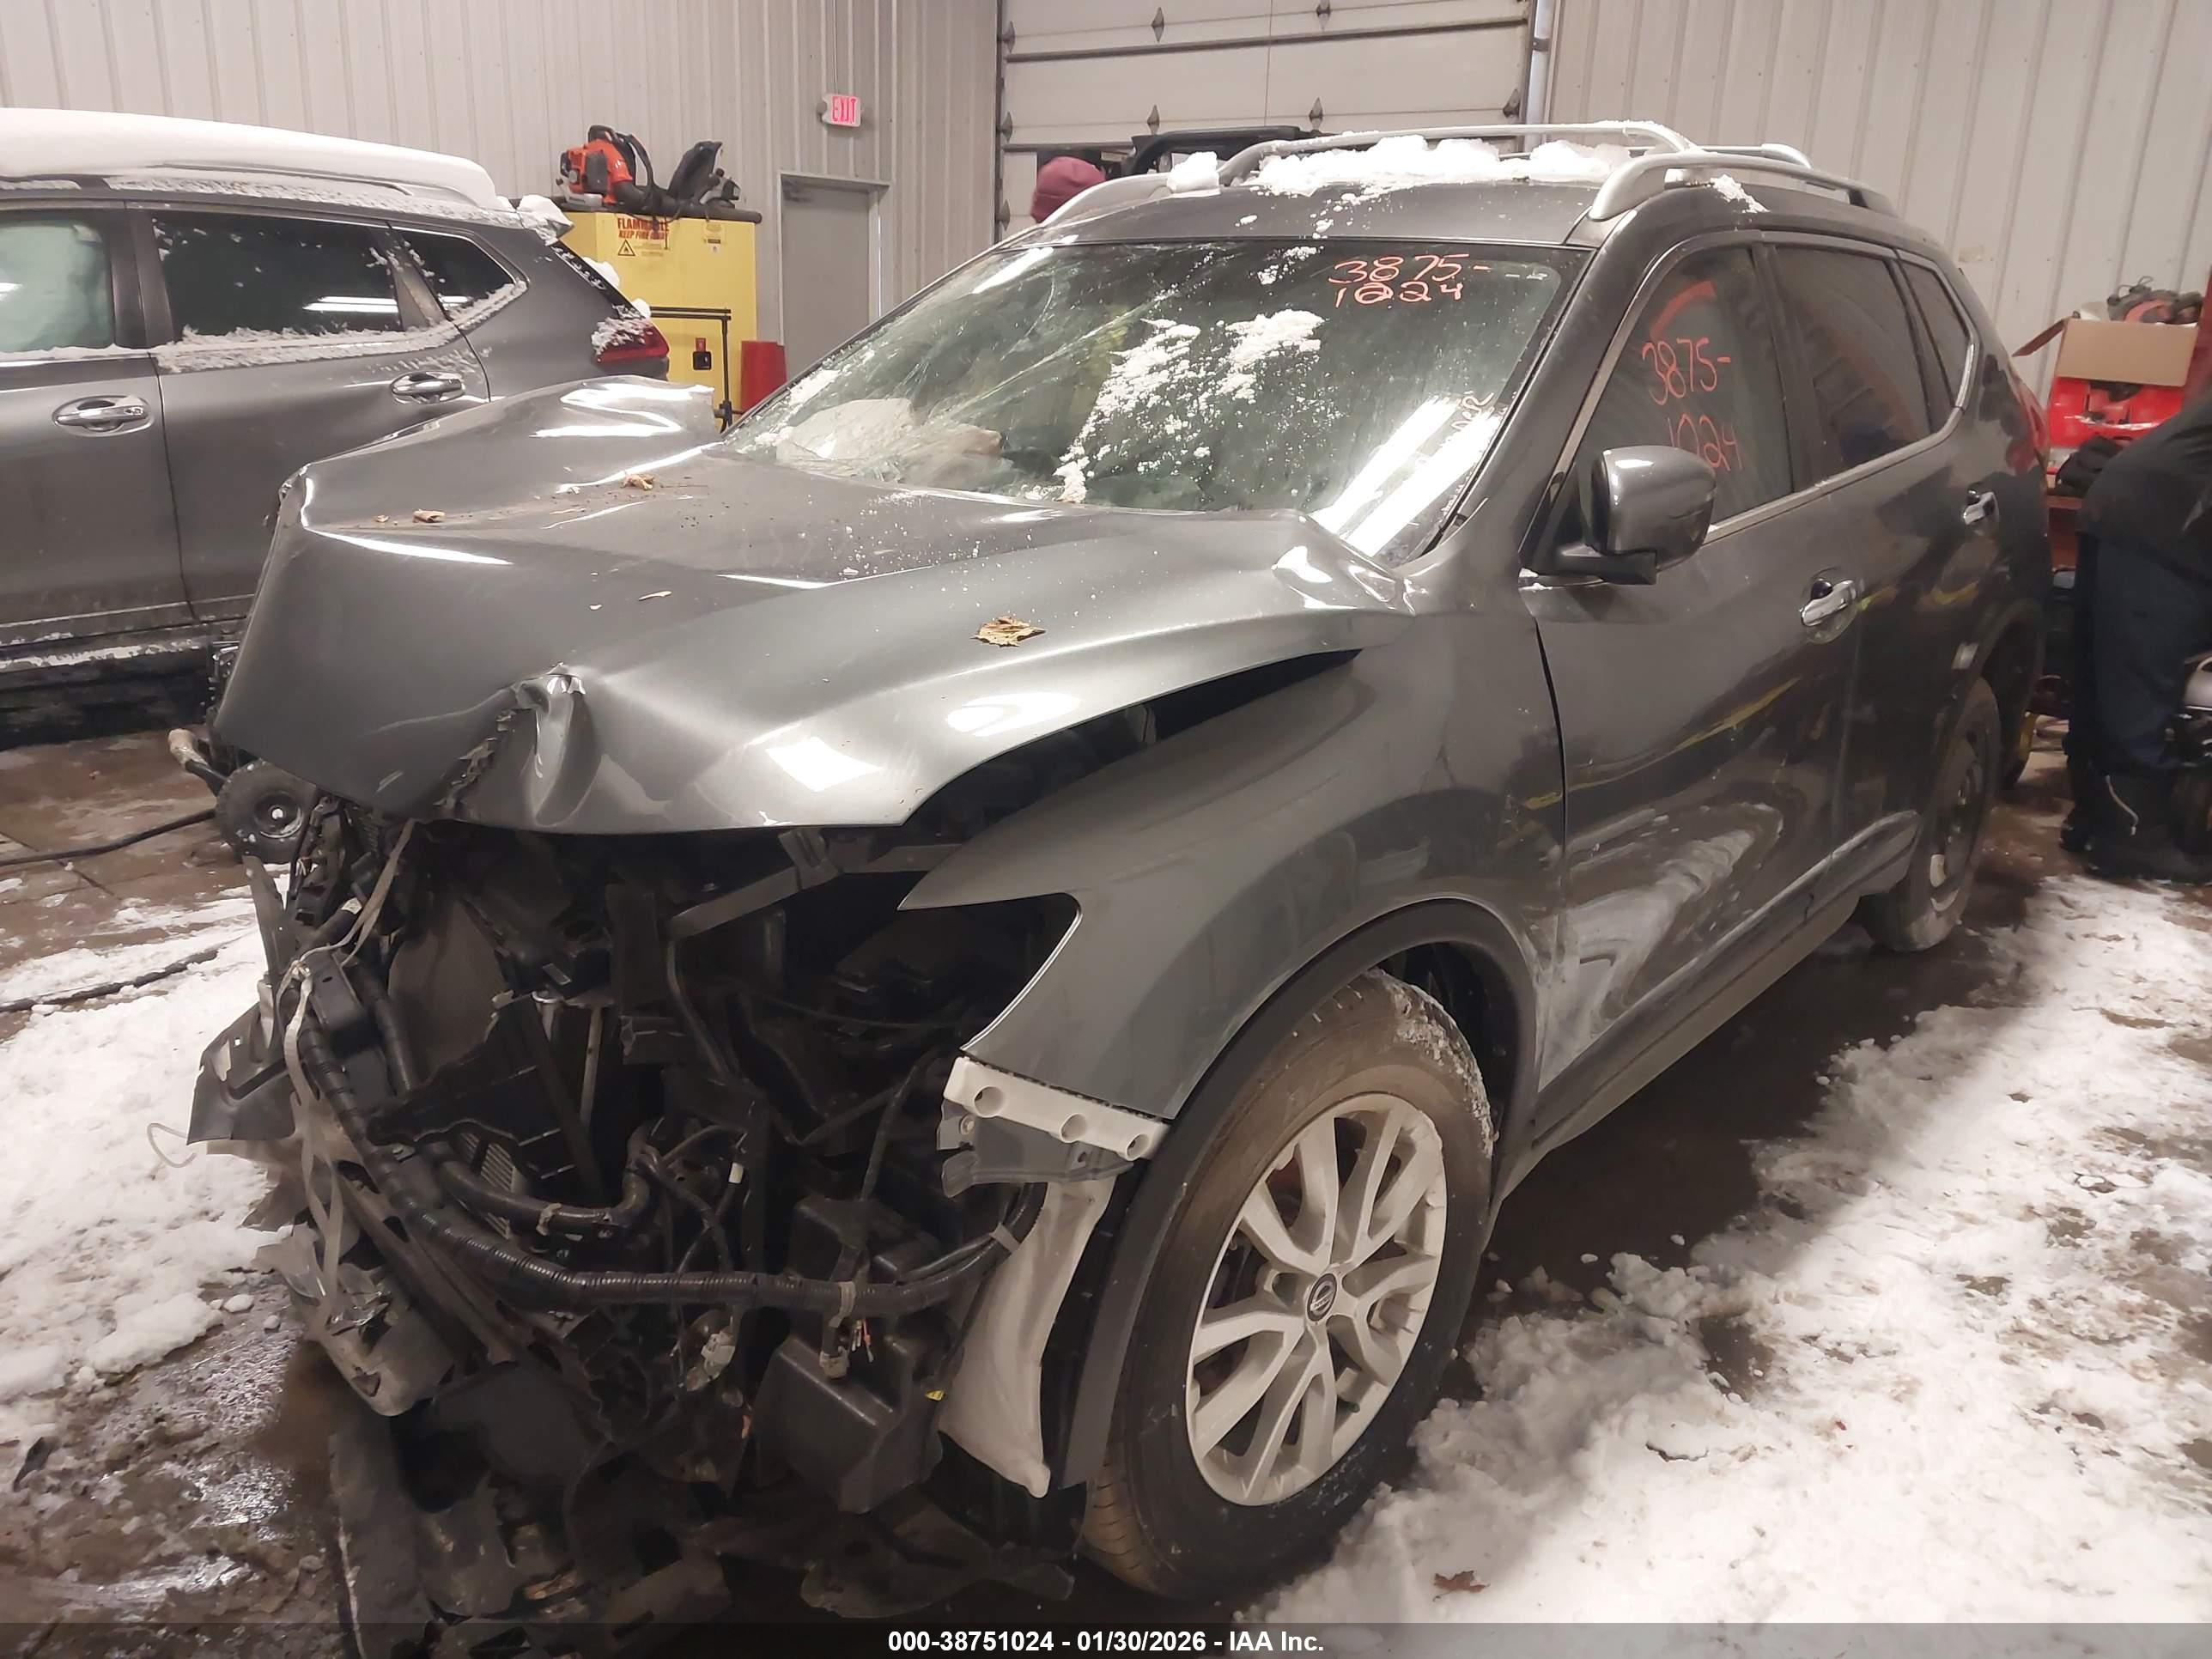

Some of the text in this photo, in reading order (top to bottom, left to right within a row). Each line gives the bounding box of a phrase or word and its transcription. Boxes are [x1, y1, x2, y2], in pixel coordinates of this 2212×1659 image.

[832, 95, 856, 124] EXIT
[617, 217, 669, 232] FLAMMLE
[618, 229, 635, 240] KEEP
